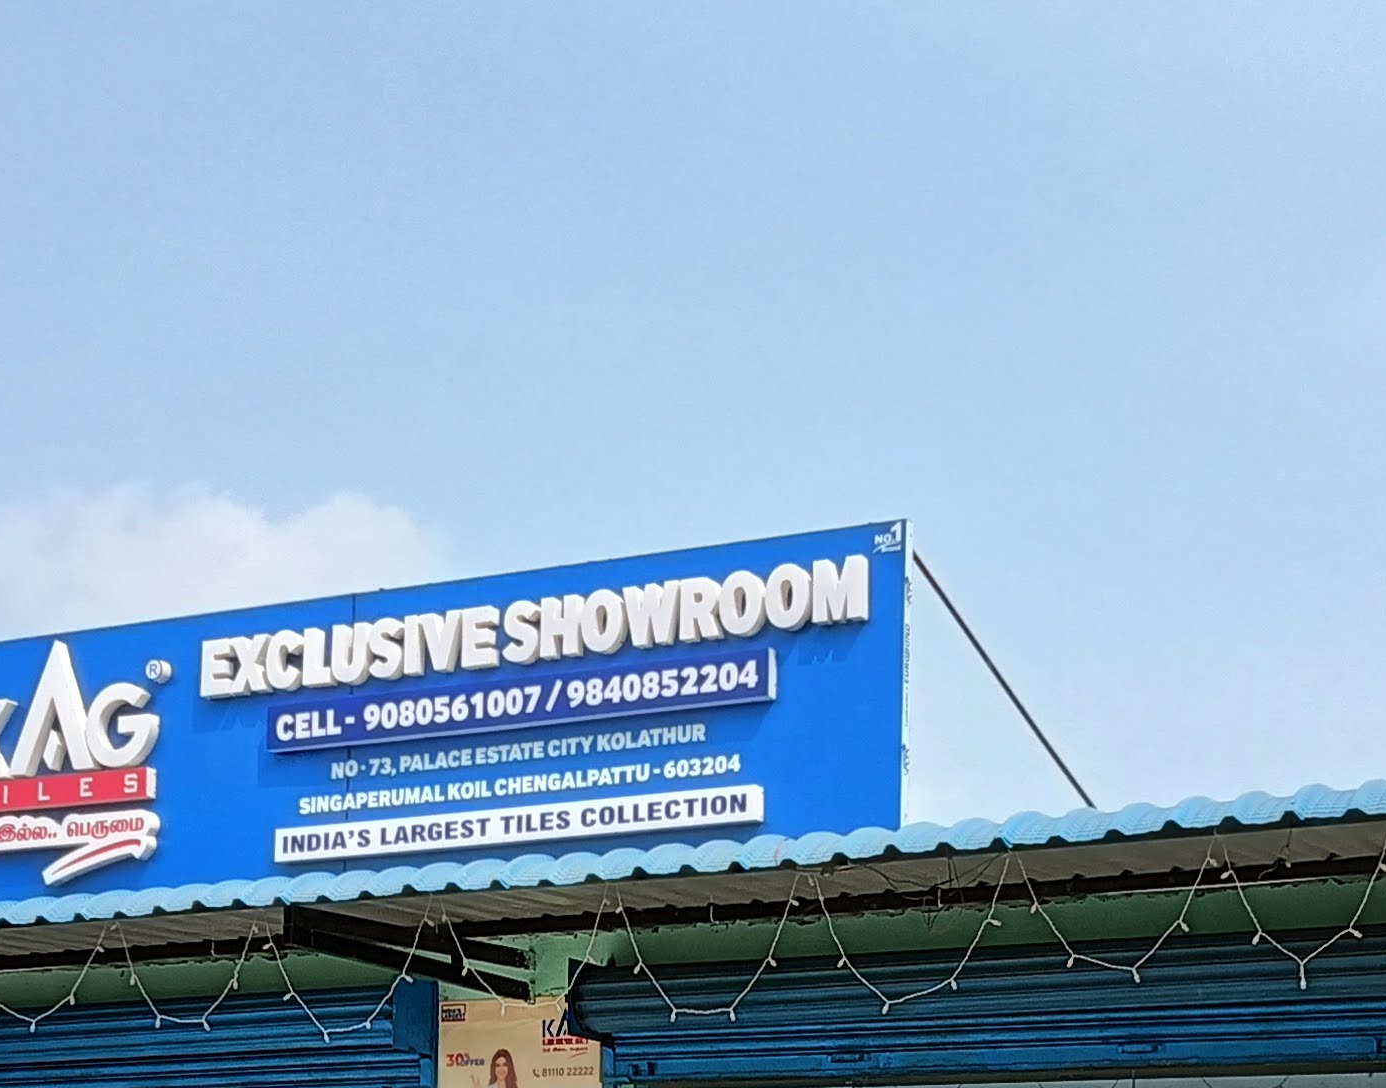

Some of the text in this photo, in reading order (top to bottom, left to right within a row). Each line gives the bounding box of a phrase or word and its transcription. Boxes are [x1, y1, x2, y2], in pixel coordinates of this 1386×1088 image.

[200, 554, 869, 699] EXCLUSIVE SHOWROOM
[363, 686, 541, 732] 9080561007
[567, 660, 759, 709] 9840852204
[399, 749, 472, 773] PALACE
[474, 741, 544, 765] ESTATE
[547, 734, 596, 758] CITY
[597, 723, 706, 752] KOLATHUR
[299, 787, 444, 815] SINGAPERUMAL
[447, 780, 492, 800] KOIL
[494, 763, 650, 797] CHENGALPATTU
[663, 754, 741, 779] 603204
[282, 793, 748, 854] INDIA'S LARGEST TILES COLLECTION
